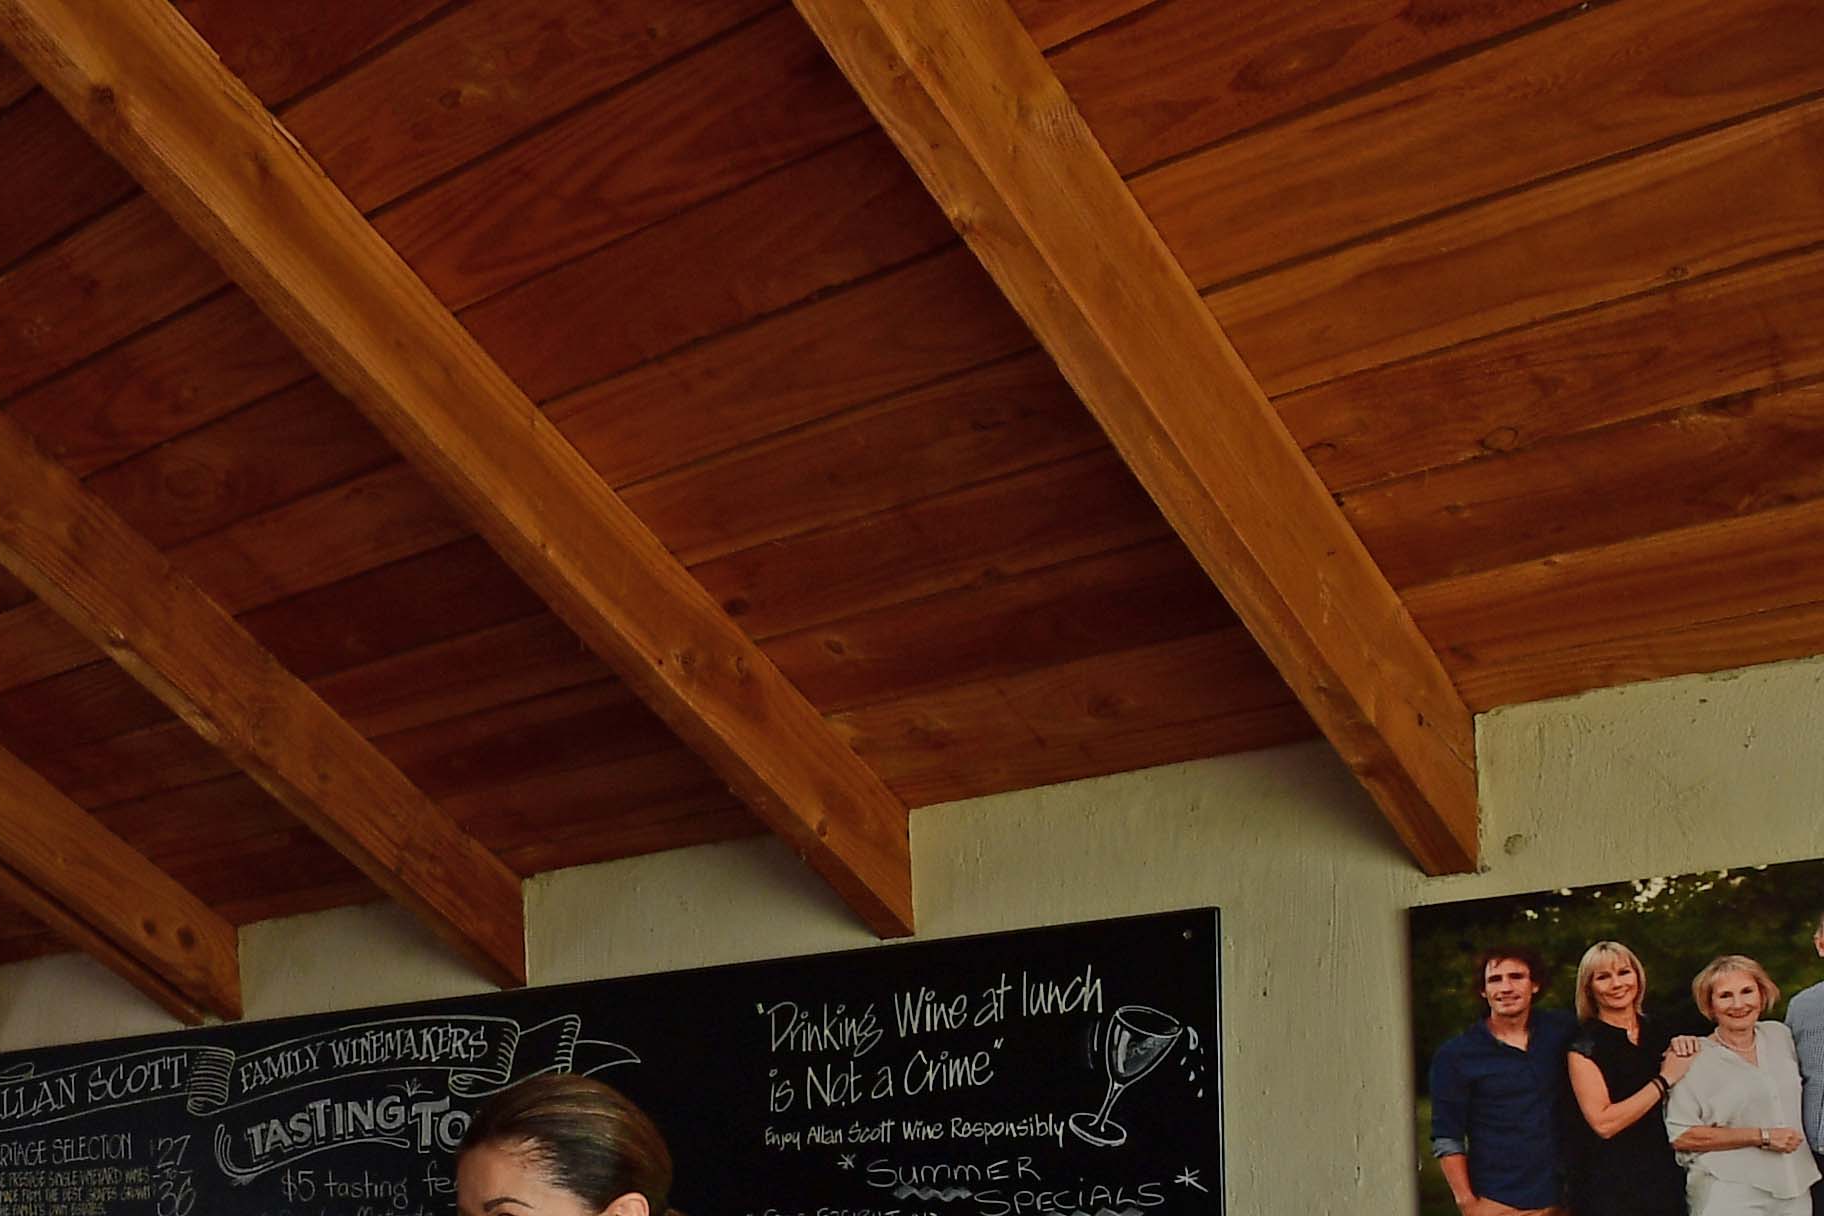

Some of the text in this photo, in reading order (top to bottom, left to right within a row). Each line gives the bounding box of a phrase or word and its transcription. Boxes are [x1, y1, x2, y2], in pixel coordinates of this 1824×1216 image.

[895, 984, 968, 1038] Wine
[973, 971, 1012, 1028] at
[1022, 963, 1103, 1019] lunch
[87, 1051, 188, 1104] SCOTT
[239, 1022, 489, 1094] FAMILY WINEMAKERS
[769, 1067, 794, 1113] is
[806, 1066, 862, 1112] Not
[872, 1070, 895, 1098] a
[51, 1131, 134, 1165] SELECTION
[245, 1095, 408, 1159] TASTING
[764, 1112, 1065, 1151] Enjoy Allan Scott Wine Responsibly
[280, 1167, 318, 1204] $5
[324, 1169, 410, 1210] tasting
